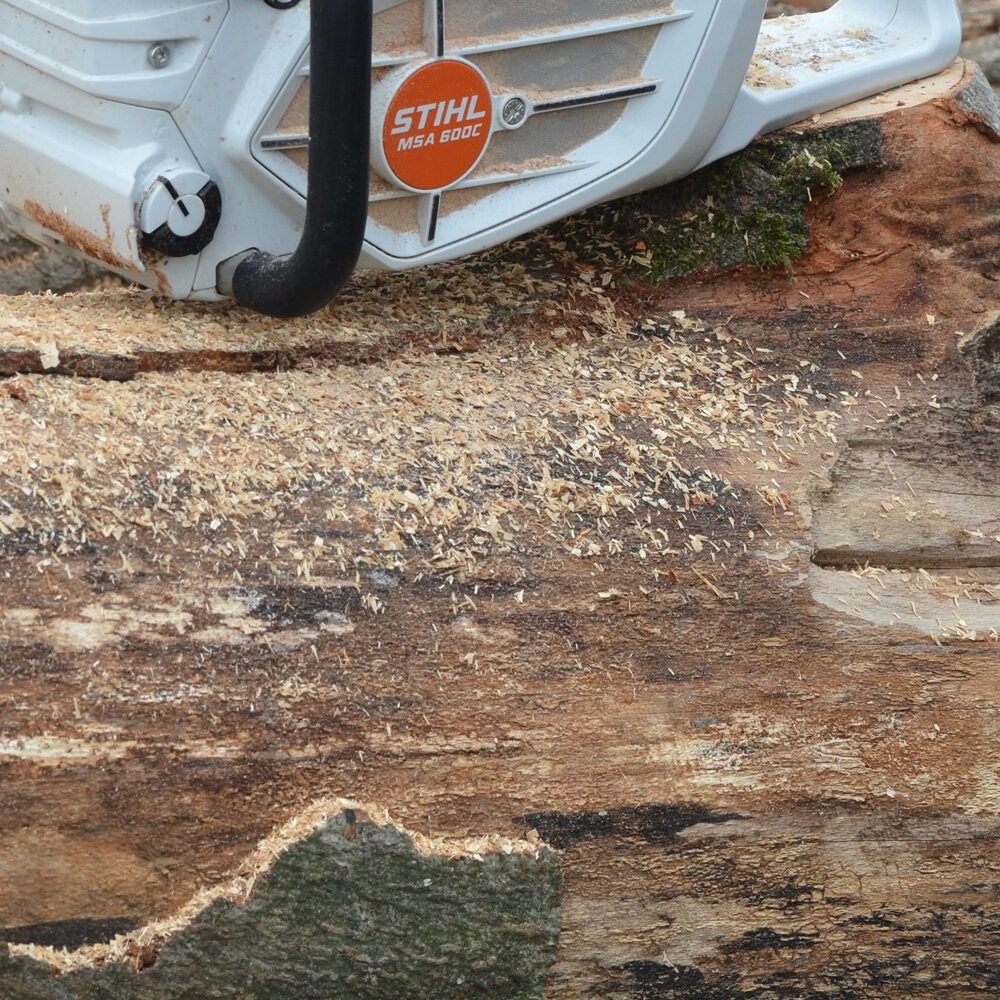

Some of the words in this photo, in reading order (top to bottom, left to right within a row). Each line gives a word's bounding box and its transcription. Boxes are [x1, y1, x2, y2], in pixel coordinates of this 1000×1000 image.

[390, 94, 486, 136] STIHL
[396, 133, 435, 152] MSA
[439, 123, 483, 143] 600C
